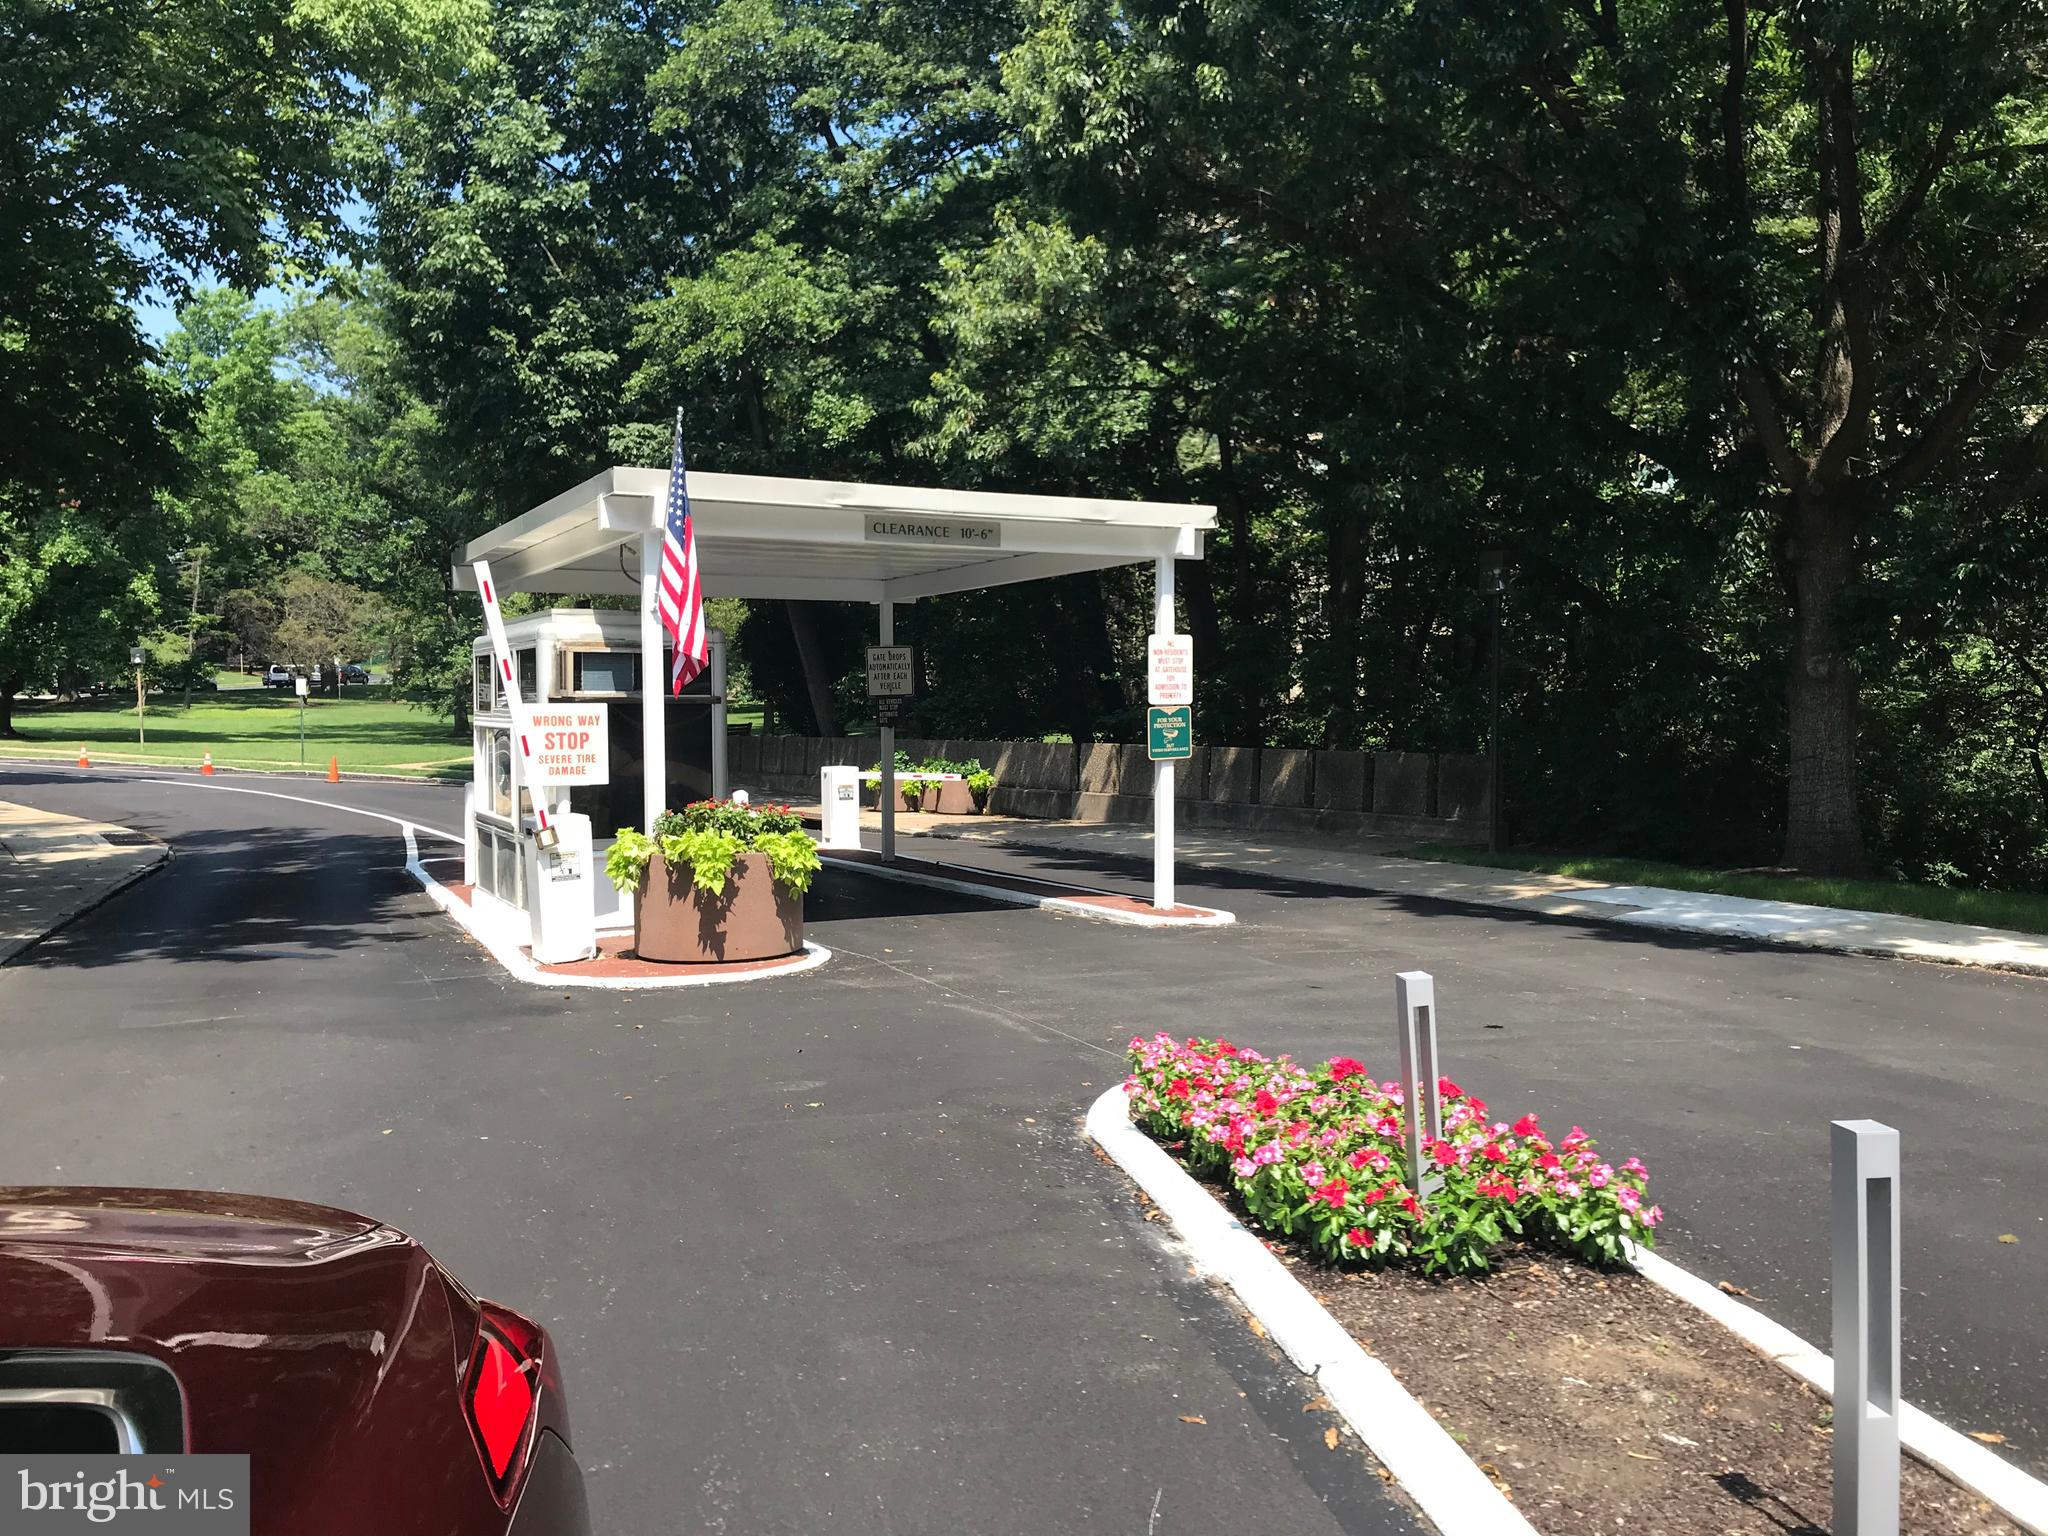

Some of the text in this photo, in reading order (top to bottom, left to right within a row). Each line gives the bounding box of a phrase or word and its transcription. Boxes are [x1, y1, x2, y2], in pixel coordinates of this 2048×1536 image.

[873, 521, 950, 538] CLEARANCE
[873, 652, 906, 661] GATE DROPS
[869, 662, 911, 671] AUTOMATICALLY
[873, 671, 908, 681] AFTER EACH
[880, 681, 902, 690] VEHICLE
[532, 714, 601, 727] WRONG WAY
[544, 732, 590, 751] STOP
[538, 753, 597, 765] SEVERE TIRE
[548, 766, 587, 776] DAMAGE
